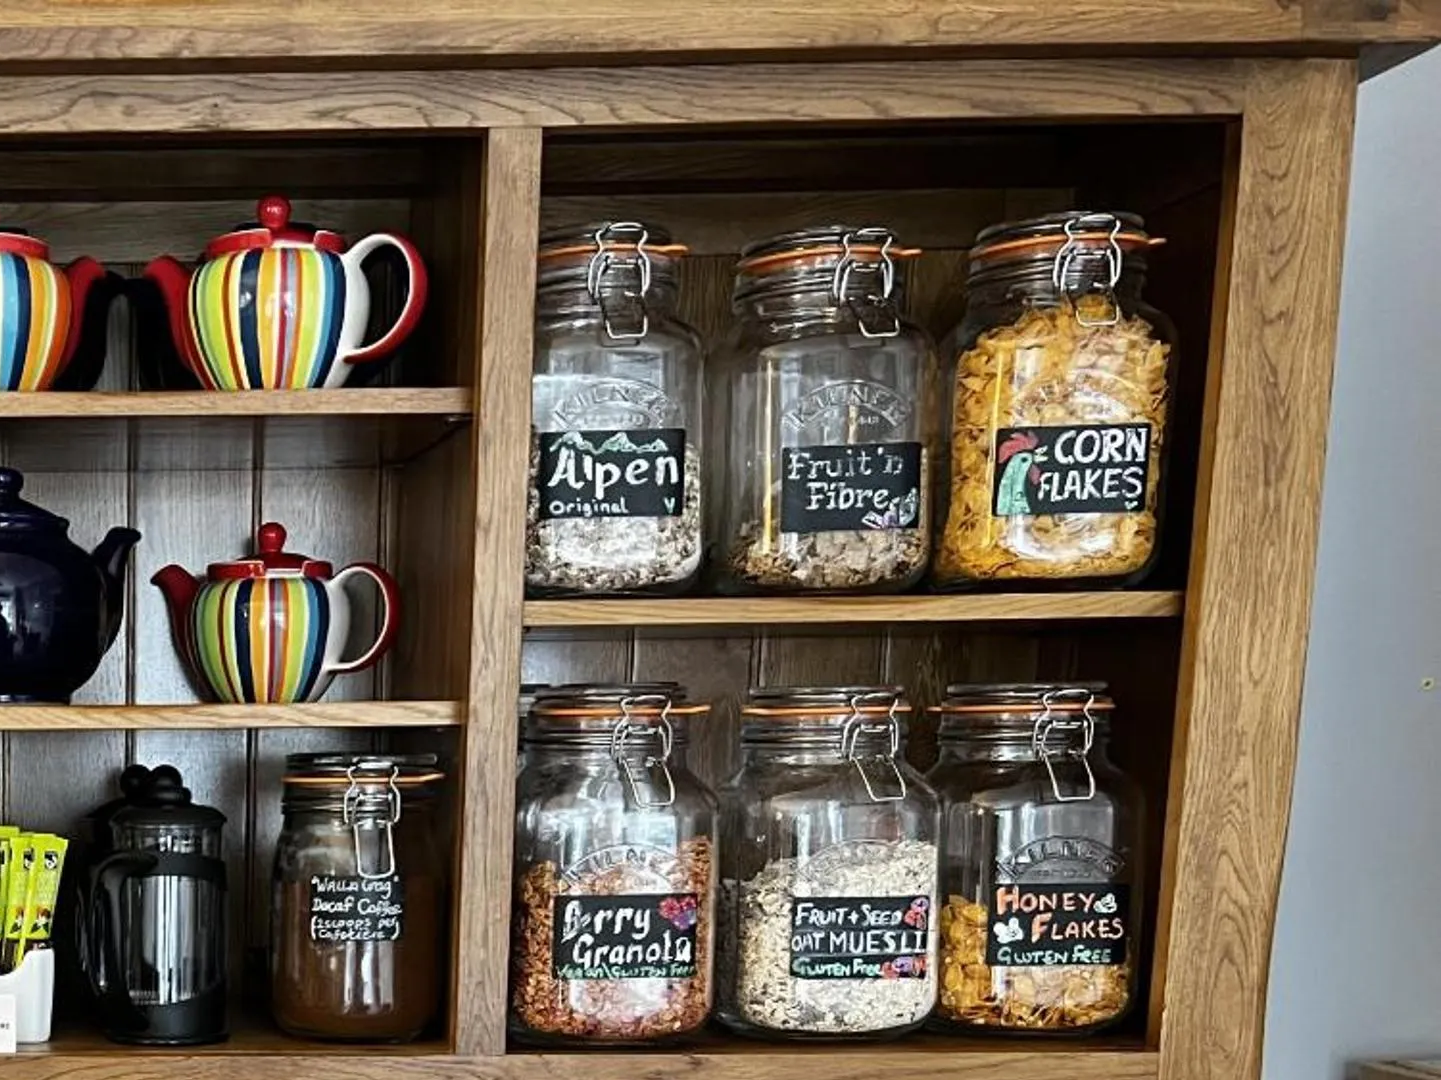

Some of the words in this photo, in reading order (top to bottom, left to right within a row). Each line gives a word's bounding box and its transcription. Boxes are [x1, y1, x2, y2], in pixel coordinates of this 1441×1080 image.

[1054, 427, 1148, 465] CORN
[547, 446, 679, 500] Alpen
[787, 449, 872, 480] Fruit
[805, 481, 889, 510] Fibre
[1037, 466, 1144, 502] FLAKES
[549, 496, 629, 518] Original
[795, 902, 848, 926] FRUIT
[861, 904, 903, 926] SEED
[996, 885, 1096, 915] HONEY
[561, 900, 650, 943] Berry
[1031, 912, 1124, 944] FLAKES
[572, 929, 691, 969] Granola
[792, 932, 825, 952] OAT
[830, 930, 926, 954] MUESLI
[997, 946, 1068, 965] GLUTEN
[1072, 944, 1112, 963] FREE
